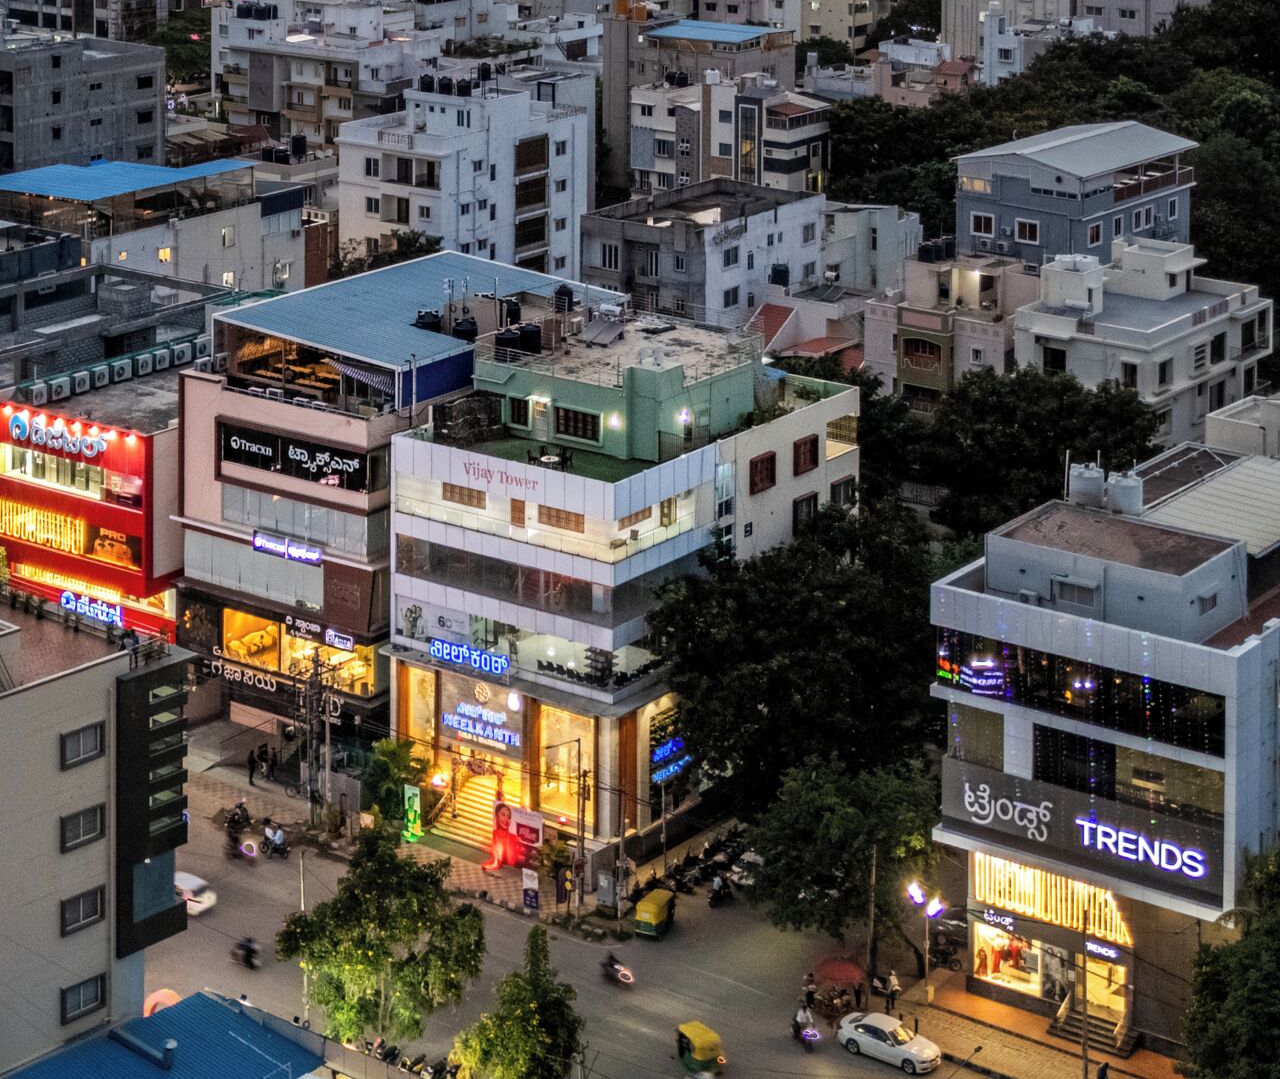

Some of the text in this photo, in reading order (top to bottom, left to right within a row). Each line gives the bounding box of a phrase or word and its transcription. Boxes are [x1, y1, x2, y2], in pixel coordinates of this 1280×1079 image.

[240, 440, 272, 456] Tracxn
[463, 461, 538, 490] Vijay Tower
[77, 595, 124, 627] digital
[442, 713, 521, 747] NEELKANTH
[1075, 818, 1205, 878] TRENDS
[1085, 942, 1118, 958] TRENDS
